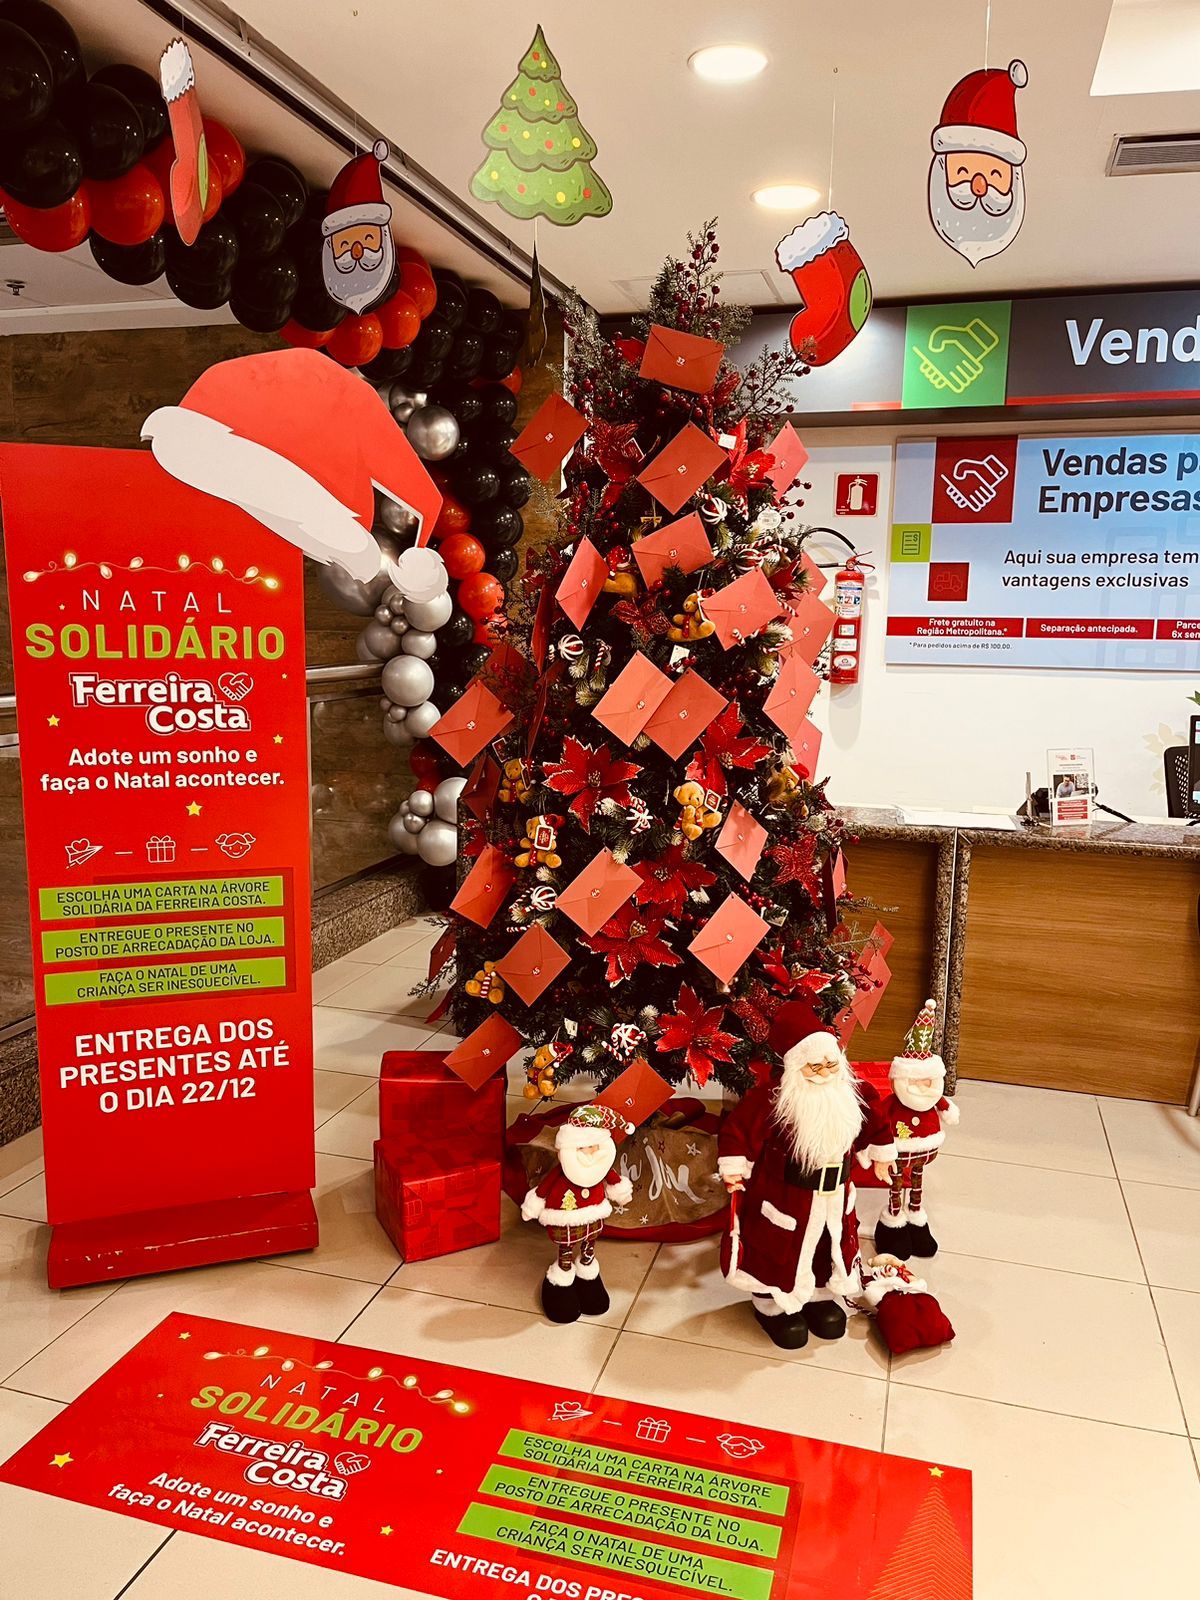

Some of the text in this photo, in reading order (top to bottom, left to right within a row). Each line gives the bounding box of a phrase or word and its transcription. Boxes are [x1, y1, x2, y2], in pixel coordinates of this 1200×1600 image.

[1042, 446, 1168, 477] Vendas
[1004, 550, 1199, 567] Aqui sua empresa tem
[1002, 573, 1190, 591] vantagens exclusivas
[82, 589, 231, 613] NATAL
[26, 617, 285, 659] SOLIDÁRIO
[916, 626, 945, 637] Região
[928, 618, 951, 627] Frete
[951, 618, 984, 629] gratuito
[1040, 624, 1139, 634] Separação antecipada.
[1171, 630, 1183, 638] 6x
[73, 674, 214, 705] Ferreira
[149, 704, 249, 732] Costa
[68, 746, 258, 767] Adote um sonho e
[40, 770, 285, 794] faça o Natal acontecer.
[57, 881, 271, 903] ESCOLHA UMA CARTA NA ÁRVORE
[62, 894, 267, 917] SOLIDÁRIA DA FERREIRA COSTA.
[55, 932, 276, 960] POSTO DE ARRECADAÇÃO DA LOJA.
[80, 922, 255, 943] ENTREGUE O PRESENTE NO
[77, 974, 261, 1000] CRIANÇA SER INESQUECÍVEL.
[99, 963, 238, 986] FAÇA O NATAL DE UMA
[75, 1018, 274, 1057] ENTREGA DOS
[59, 1040, 290, 1089] PRESENTES ATÉ
[99, 1076, 256, 1114] O DIA 22/12
[260, 1374, 387, 1413] NATAL
[190, 1385, 424, 1454] SOLIDÁRIO
[196, 1423, 327, 1472] Ferreira
[247, 1461, 347, 1500] Costa
[523, 1436, 773, 1498] ESCOLHA UMA CARTA NA ÁRVORE
[523, 1448, 762, 1509] SOLIDÁRIA DA FERREIRA COSTA.
[149, 1472, 334, 1529] Adote um sonho e
[528, 1476, 741, 1532] ENTREGUE O PRESENTE NO
[107, 1483, 346, 1556] faça o Natal acontecer.
[494, 1482, 764, 1552] POSTO DE ARRECADAÇÃO DA LOJA.
[496, 1526, 733, 1592] CRIANÇA SER INESQUECÍVEL.
[529, 1519, 704, 1570] FAÇA O NATAL DE UMA
[429, 1548, 531, 1587] ENTREGA
[535, 1574, 582, 1598] DOS
